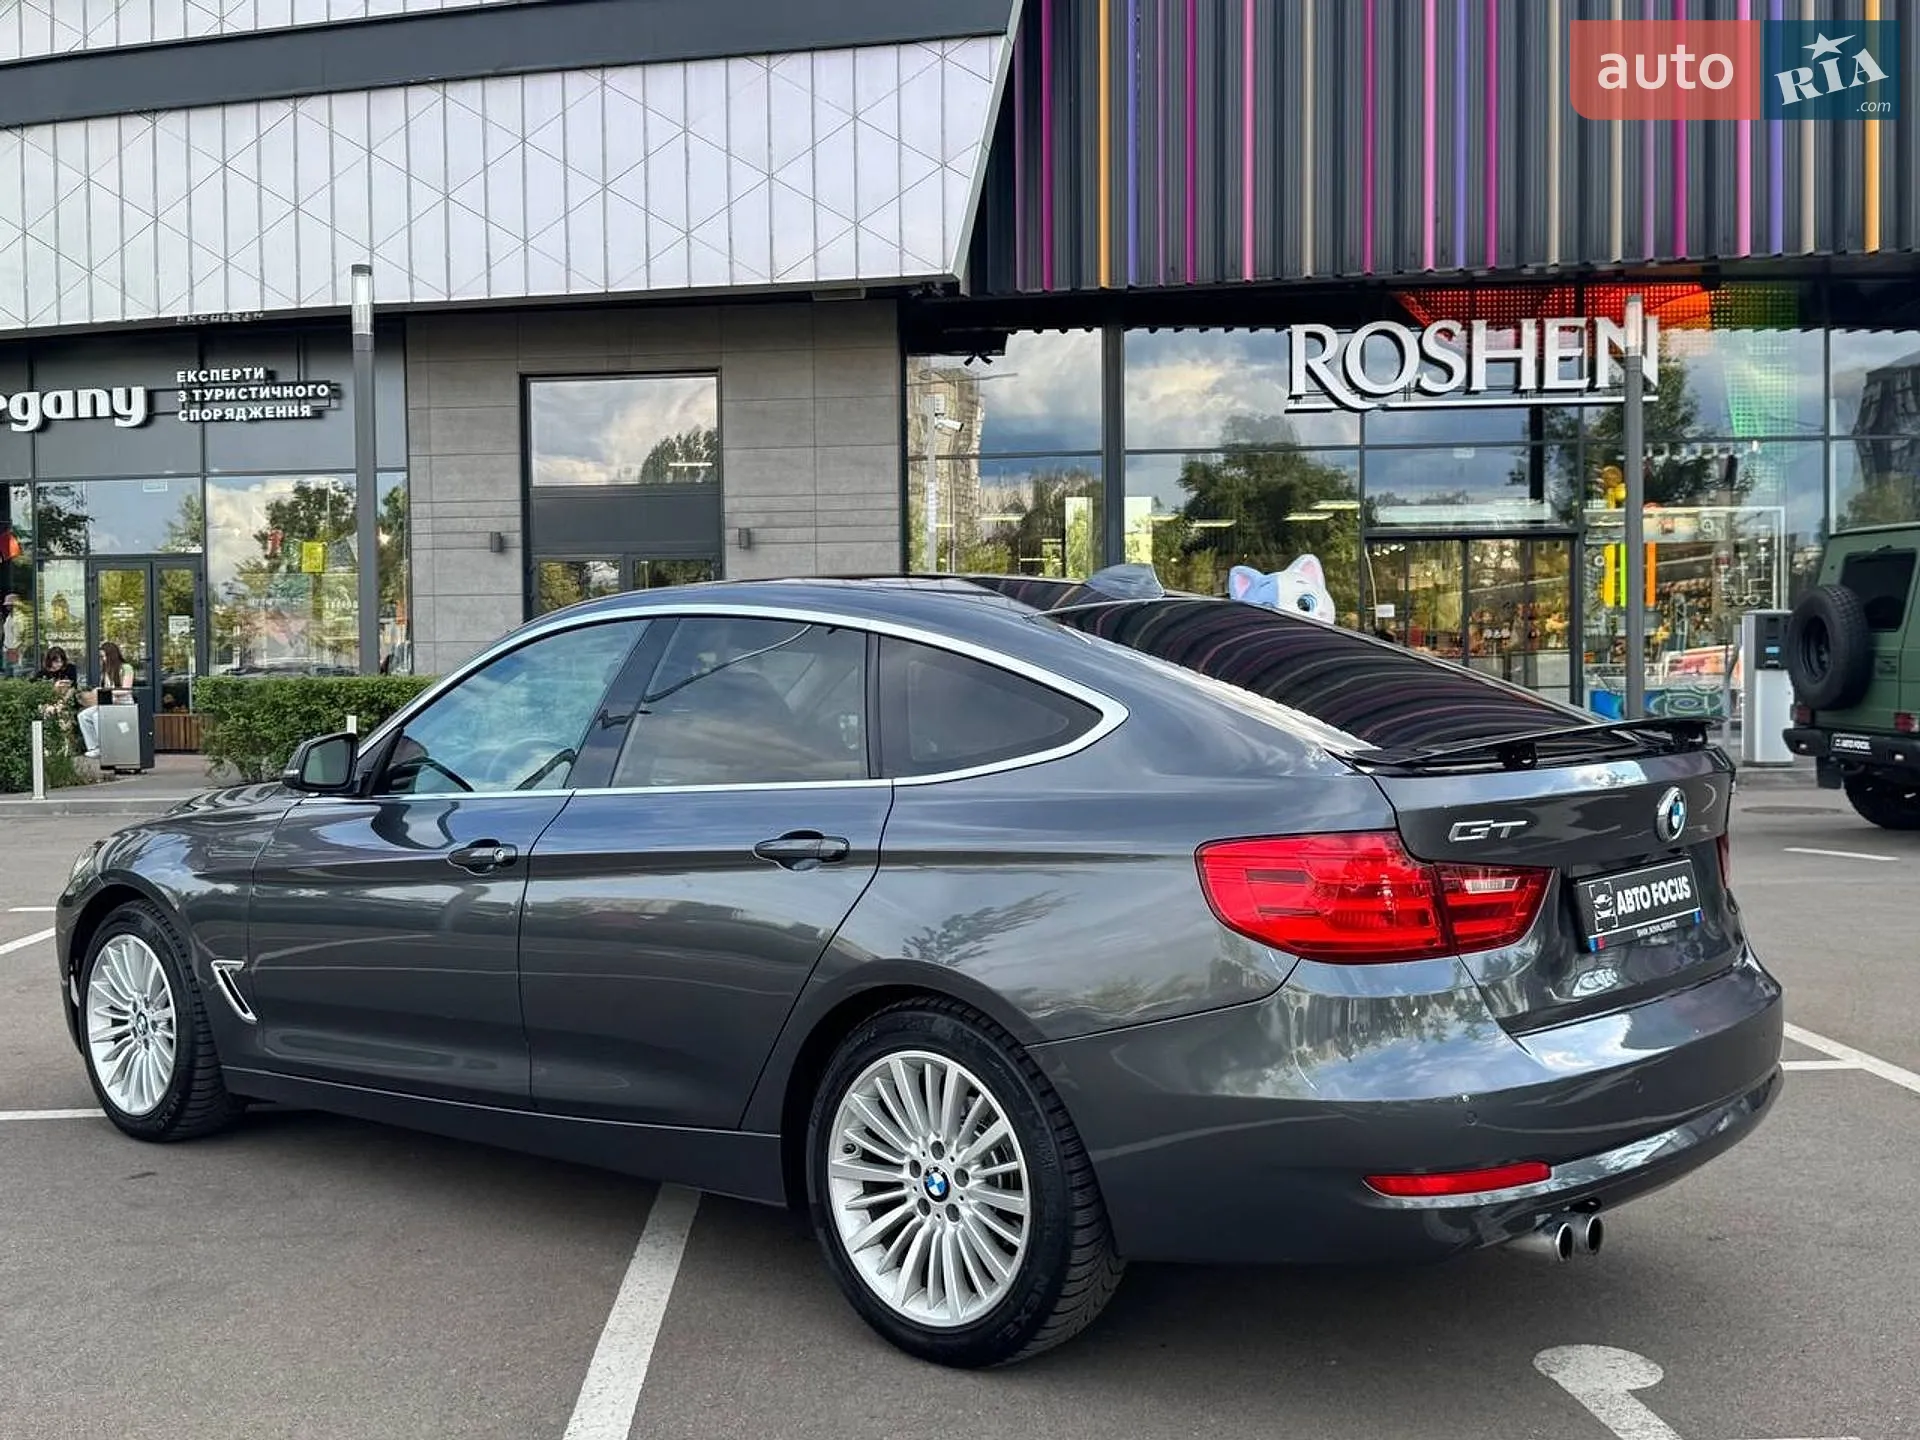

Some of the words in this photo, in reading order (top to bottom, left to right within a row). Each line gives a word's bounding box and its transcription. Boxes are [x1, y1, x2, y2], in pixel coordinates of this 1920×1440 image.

[1289, 316, 1659, 411] ROSHEN
[176, 367, 265, 383] ЕКСПЕРТИ
[192, 384, 329, 402] ТУРИСТИЧНОГО
[178, 405, 312, 422] СПОРЯДЖЕННЯ
[1449, 820, 1528, 842] GT
[1650, 875, 1692, 907] FOCUS
